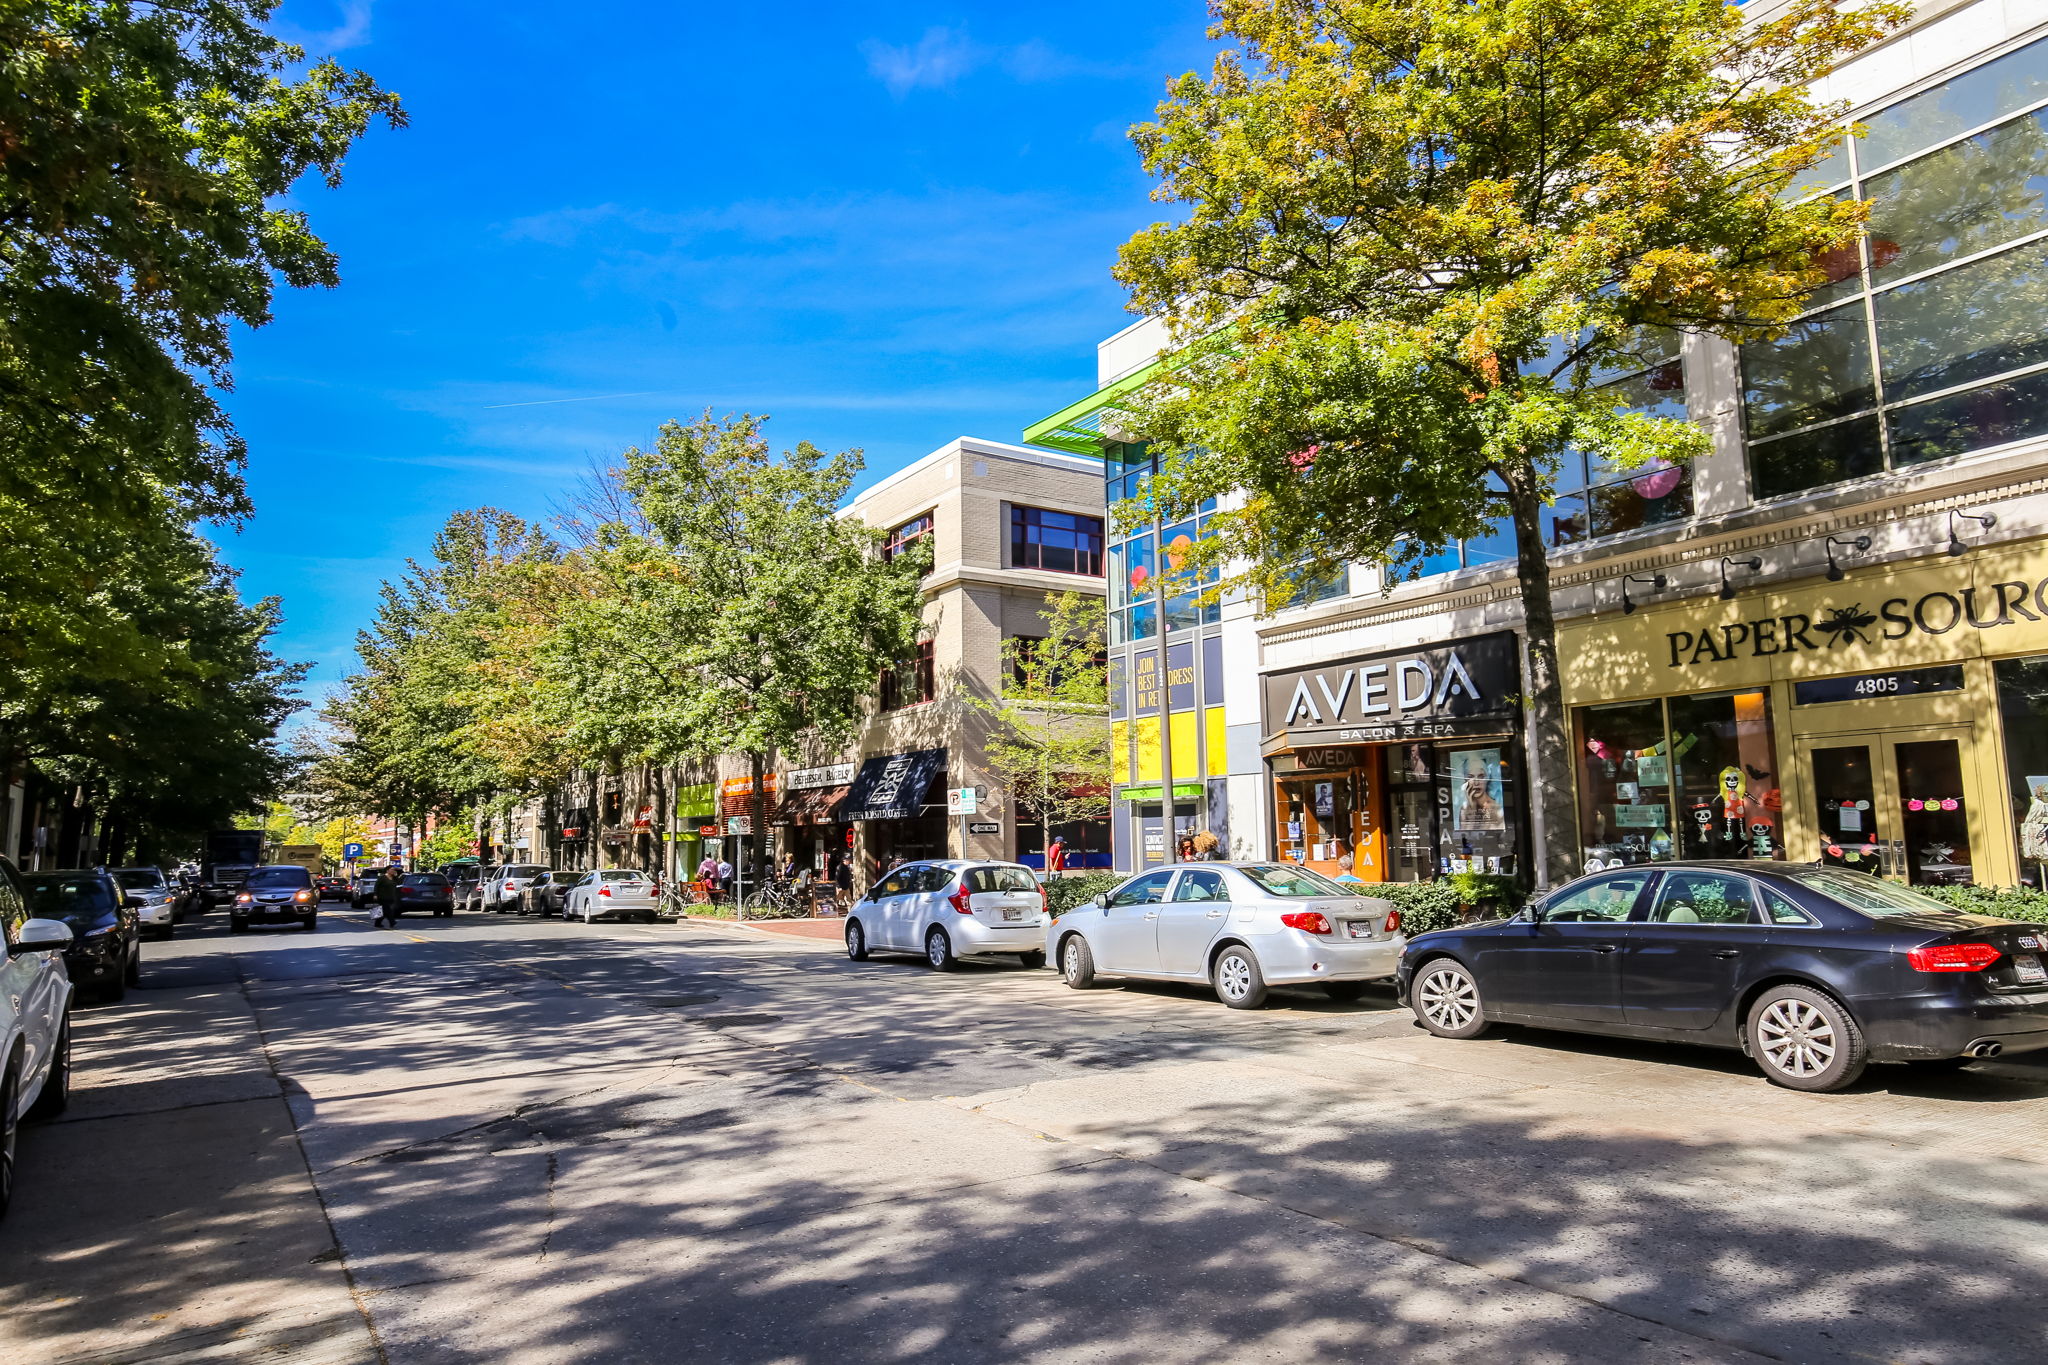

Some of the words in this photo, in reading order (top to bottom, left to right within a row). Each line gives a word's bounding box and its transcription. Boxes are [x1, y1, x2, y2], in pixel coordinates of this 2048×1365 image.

[1666, 613, 1819, 668] PAPER
[1138, 656, 1154, 675] JOIN
[1138, 673, 1156, 691] BEST
[1284, 651, 1481, 724] AVEDA
[1854, 677, 1900, 694] 4805
[1138, 692, 1146, 709] IN
[1148, 689, 1173, 707] RETL
[1339, 728, 1396, 739] SALON
[1403, 726, 1416, 736] &
[1421, 724, 1456, 735] SPA
[1305, 749, 1357, 766] AVEDA
[794, 772, 823, 785] BETHESDA
[826, 769, 849, 781] BAGELS
[1438, 787, 1453, 845] SPA
[349, 844, 359, 855] P
